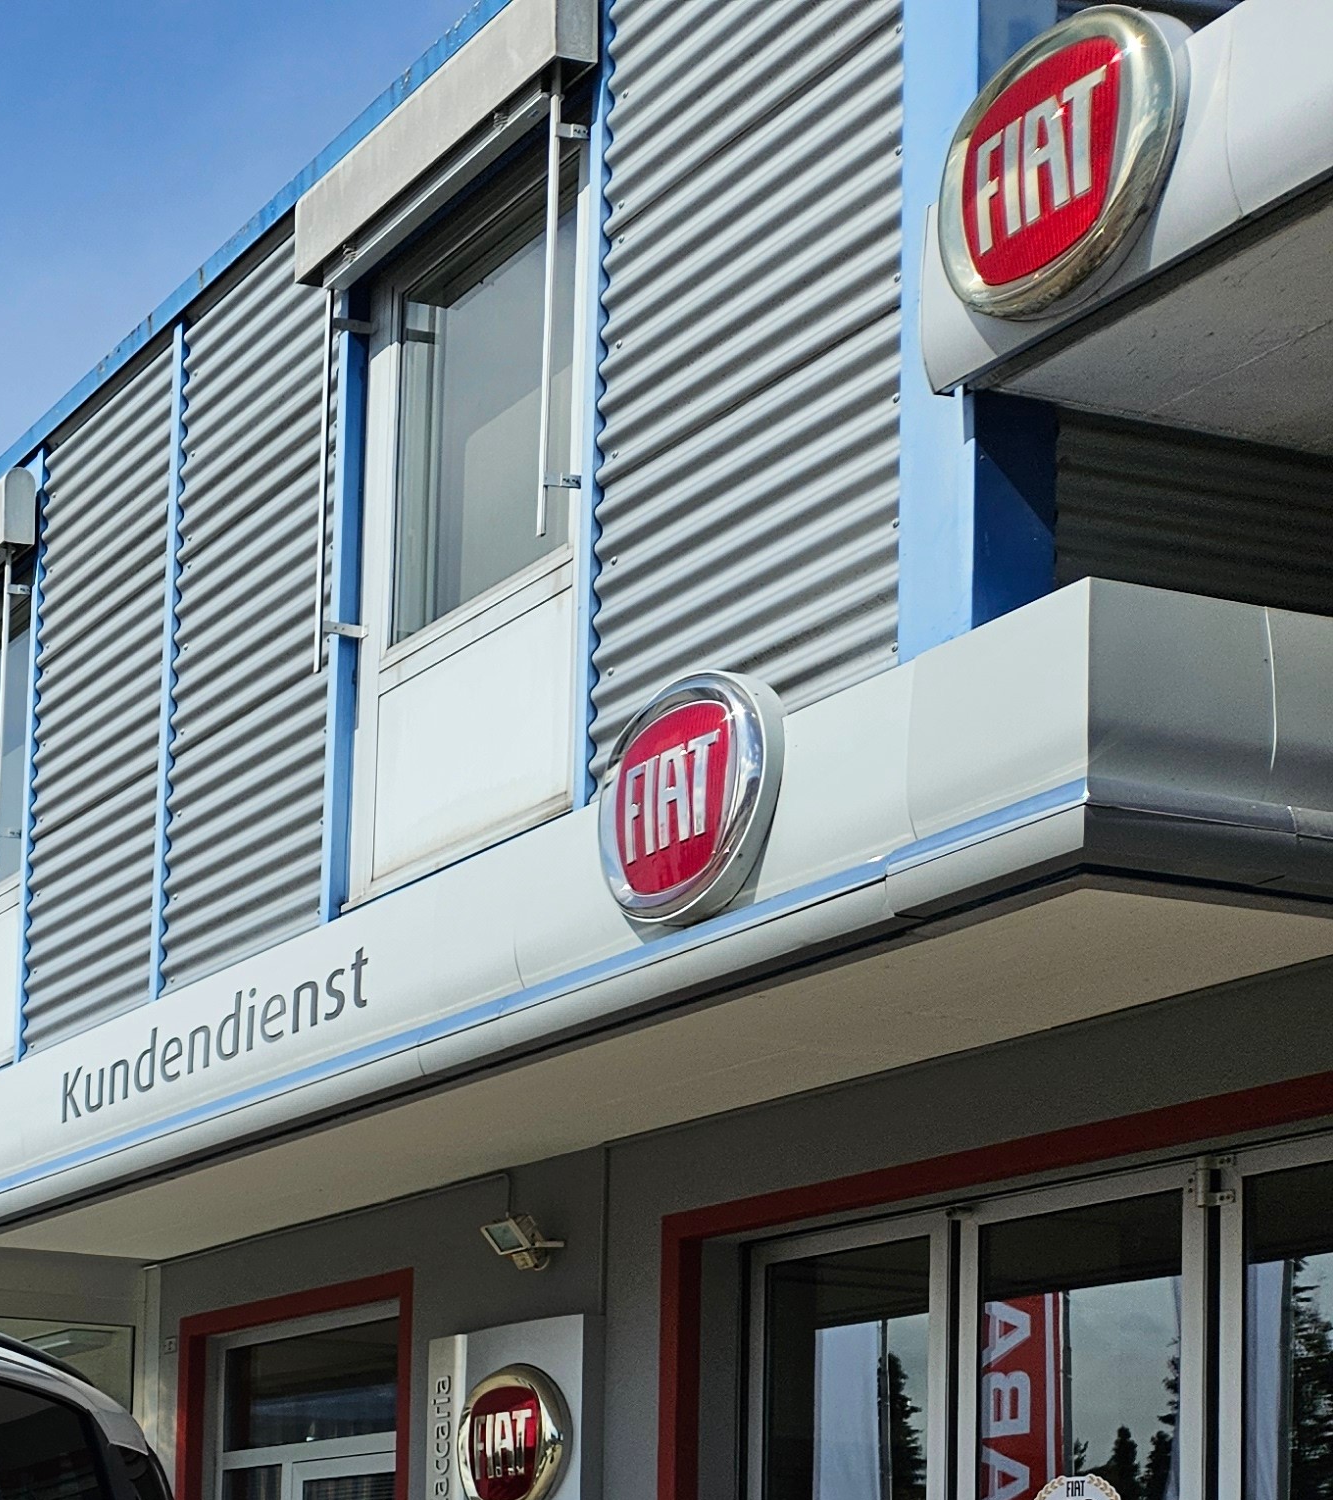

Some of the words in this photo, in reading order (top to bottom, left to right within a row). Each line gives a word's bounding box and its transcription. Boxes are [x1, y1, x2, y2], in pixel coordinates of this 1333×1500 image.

[976, 65, 1107, 257] FIAT
[625, 728, 721, 865] FIAT
[61, 946, 369, 1124] Kundendienst
[473, 1408, 533, 1480] FIAT
[1066, 1480, 1086, 1497] FIAT
